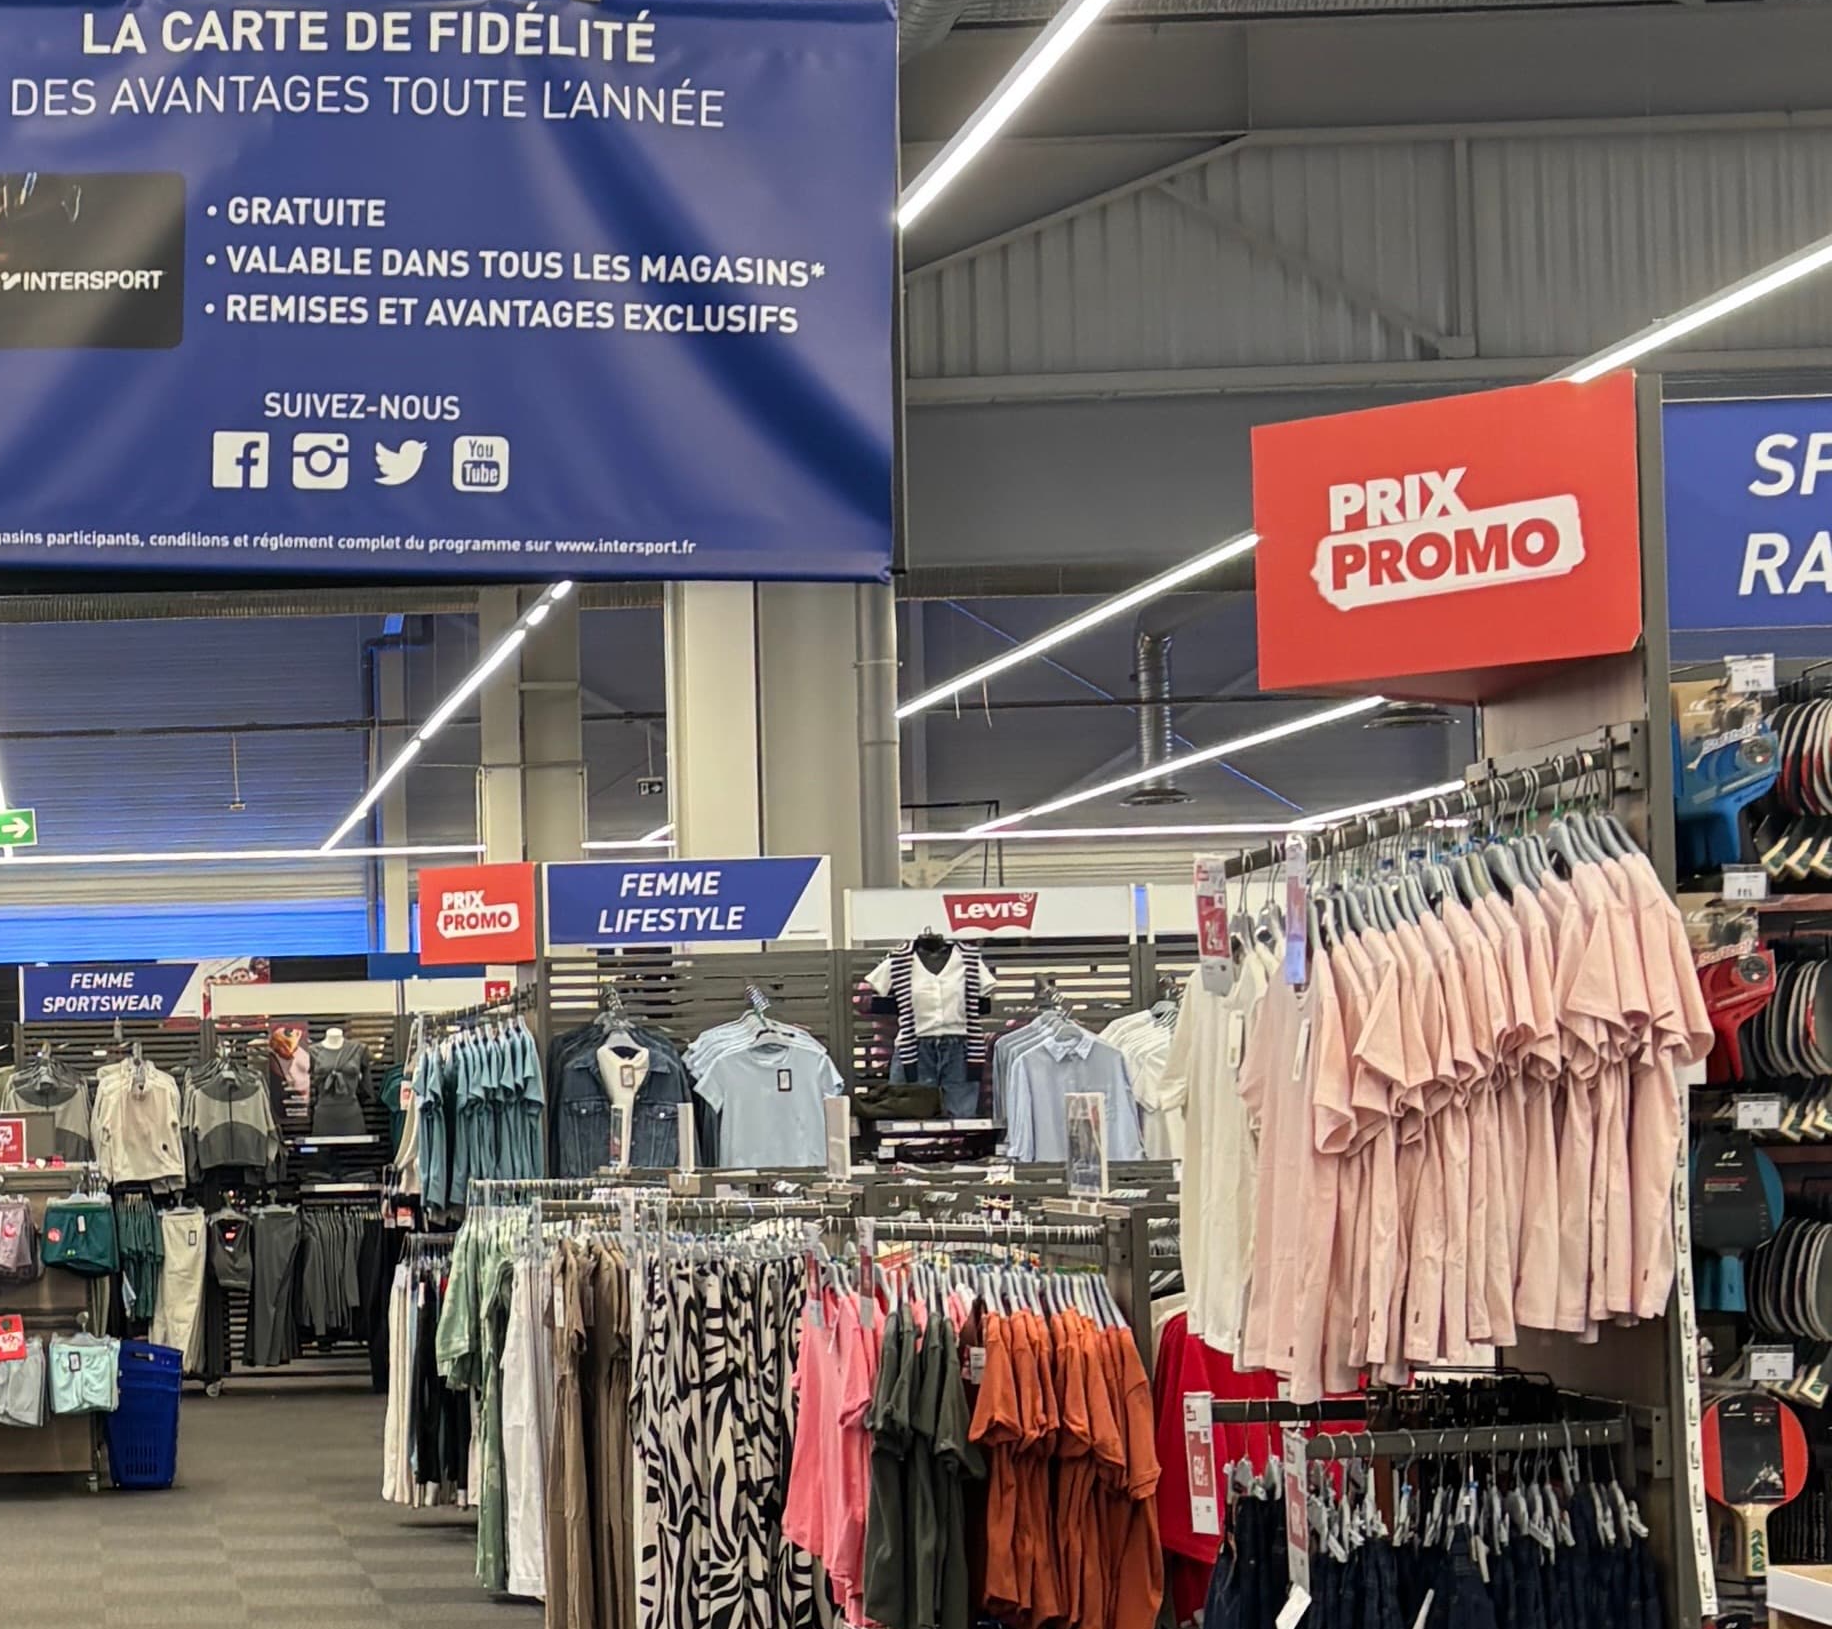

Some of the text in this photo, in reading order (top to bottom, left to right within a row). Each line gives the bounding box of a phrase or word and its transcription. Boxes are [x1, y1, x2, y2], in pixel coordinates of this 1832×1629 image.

[83, 1, 656, 63] LA CARTE DE FIDÉLITÉ
[11, 75, 725, 128] DES AVANTAGES TOUTE L'ANNÉE
[228, 196, 386, 227] GRATUITE
[226, 246, 372, 276] VALABLE
[382, 249, 470, 277] DANS
[478, 250, 564, 279] TOUS
[573, 253, 631, 283] LES
[23, 270, 163, 291] INTERSPORT
[226, 295, 799, 334] REMISES ET AVANTAGES EXCLUSIFS
[264, 392, 461, 421] SUIVEZ-NOUS
[468, 439, 494, 459] You
[462, 462, 499, 484] Tube
[1328, 466, 1468, 532] PRIX
[46, 529, 145, 549] participants,
[149, 531, 230, 548] conditions
[233, 533, 249, 549] et
[337, 535, 401, 553] complet
[404, 535, 425, 550] du
[428, 539, 521, 556] programme
[525, 540, 552, 552] sur
[555, 538, 696, 556] www.intersport.fr
[1331, 517, 1561, 591] PROMO
[1738, 530, 1832, 596] RA
[620, 870, 722, 898] FEMME
[441, 889, 485, 910] PRIX
[443, 911, 512, 931] PROMO
[598, 906, 746, 934] LIFESTYLE
[70, 972, 136, 989] FEMME
[42, 994, 164, 1013] SPORTSWEAR
